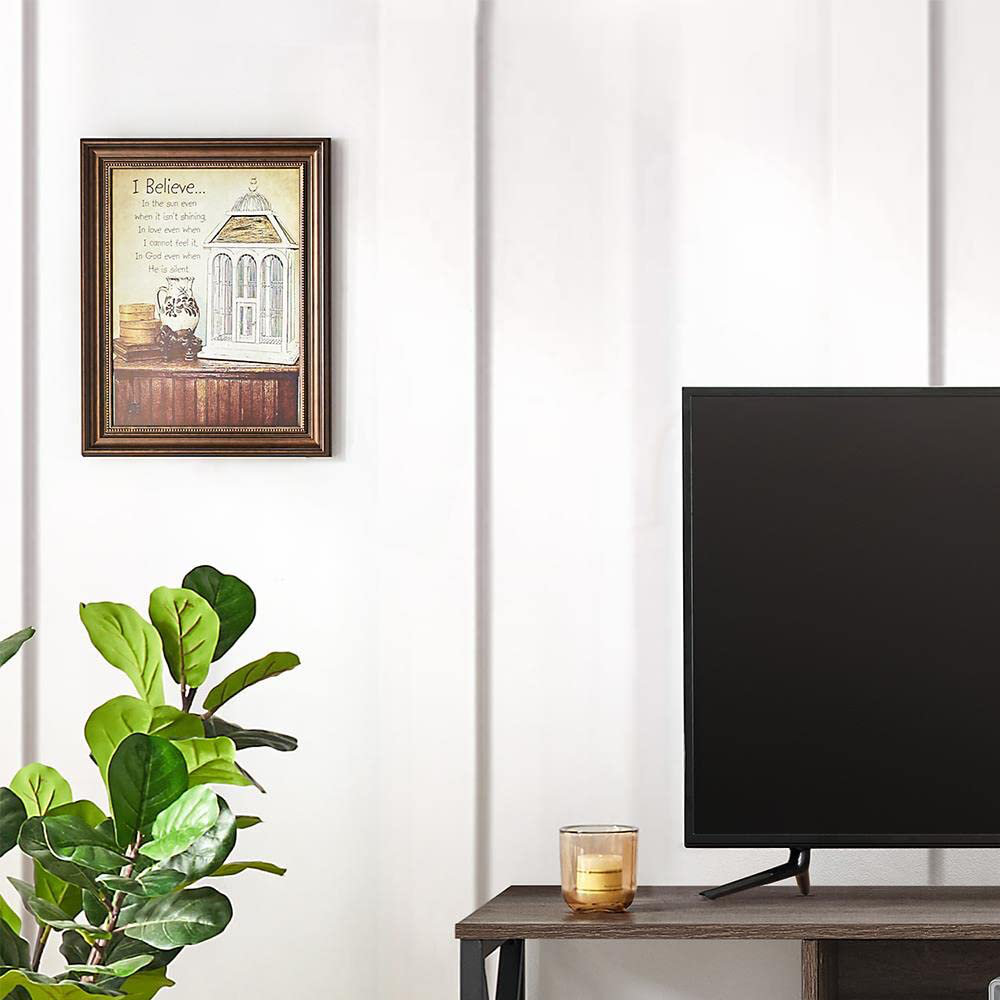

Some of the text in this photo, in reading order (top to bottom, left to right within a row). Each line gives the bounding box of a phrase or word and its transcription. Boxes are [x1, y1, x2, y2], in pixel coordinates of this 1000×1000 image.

[132, 177, 206, 195] I Believe...
[142, 200, 150, 208] In
[152, 200, 164, 208] the
[134, 212, 153, 220] when
[155, 212, 161, 220] it
[163, 212, 178, 221] isn't
[138, 226, 146, 234] In
[147, 226, 161, 234] love
[182, 226, 201, 234] when
[143, 239, 147, 247] I
[175, 239, 189, 247] feel
[135, 252, 143, 260] In
[145, 251, 162, 260] God
[182, 252, 201, 260] when
[148, 265, 159, 273] He
[160, 265, 168, 273] is
